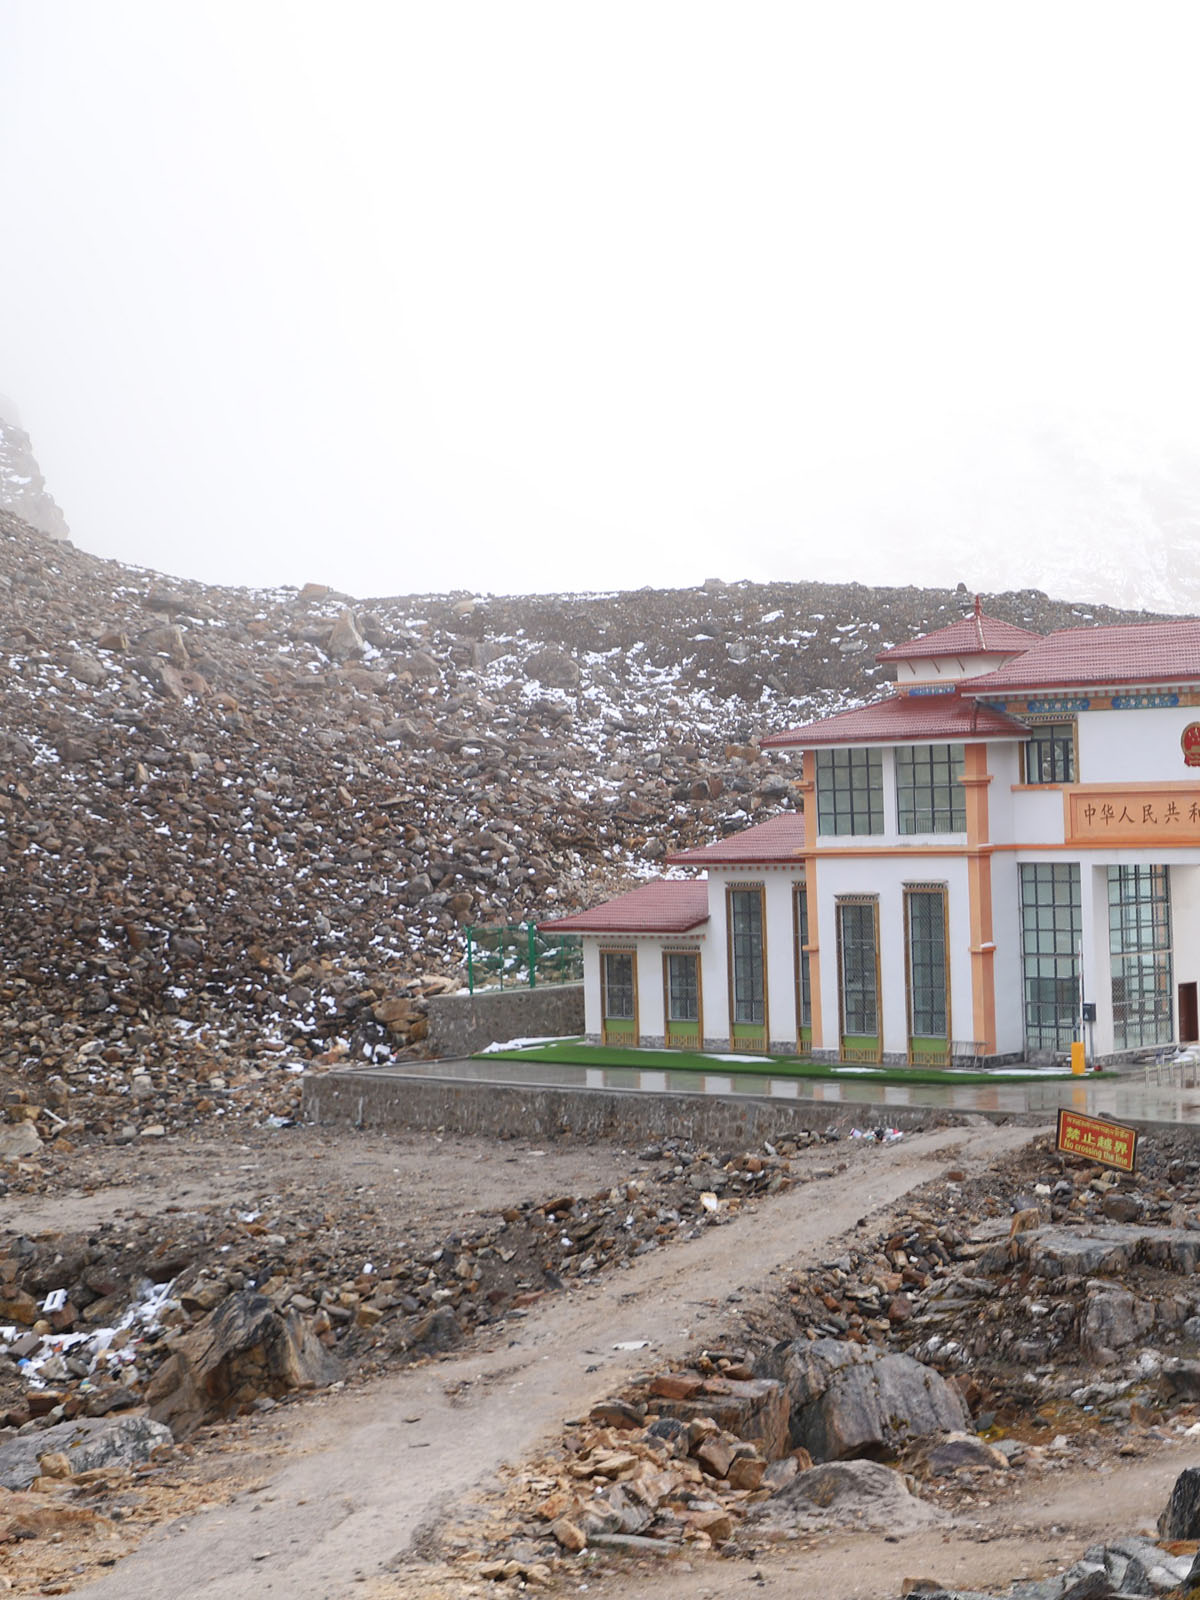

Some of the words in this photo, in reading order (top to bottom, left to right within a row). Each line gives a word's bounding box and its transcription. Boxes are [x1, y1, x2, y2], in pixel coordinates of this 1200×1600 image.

[1064, 1138, 1074, 1149] No
[1075, 1144, 1102, 1159] crossing
[1103, 1151, 1114, 1162] the
[1115, 1153, 1128, 1165] line
[1065, 1127, 1129, 1155] 禁止越界
